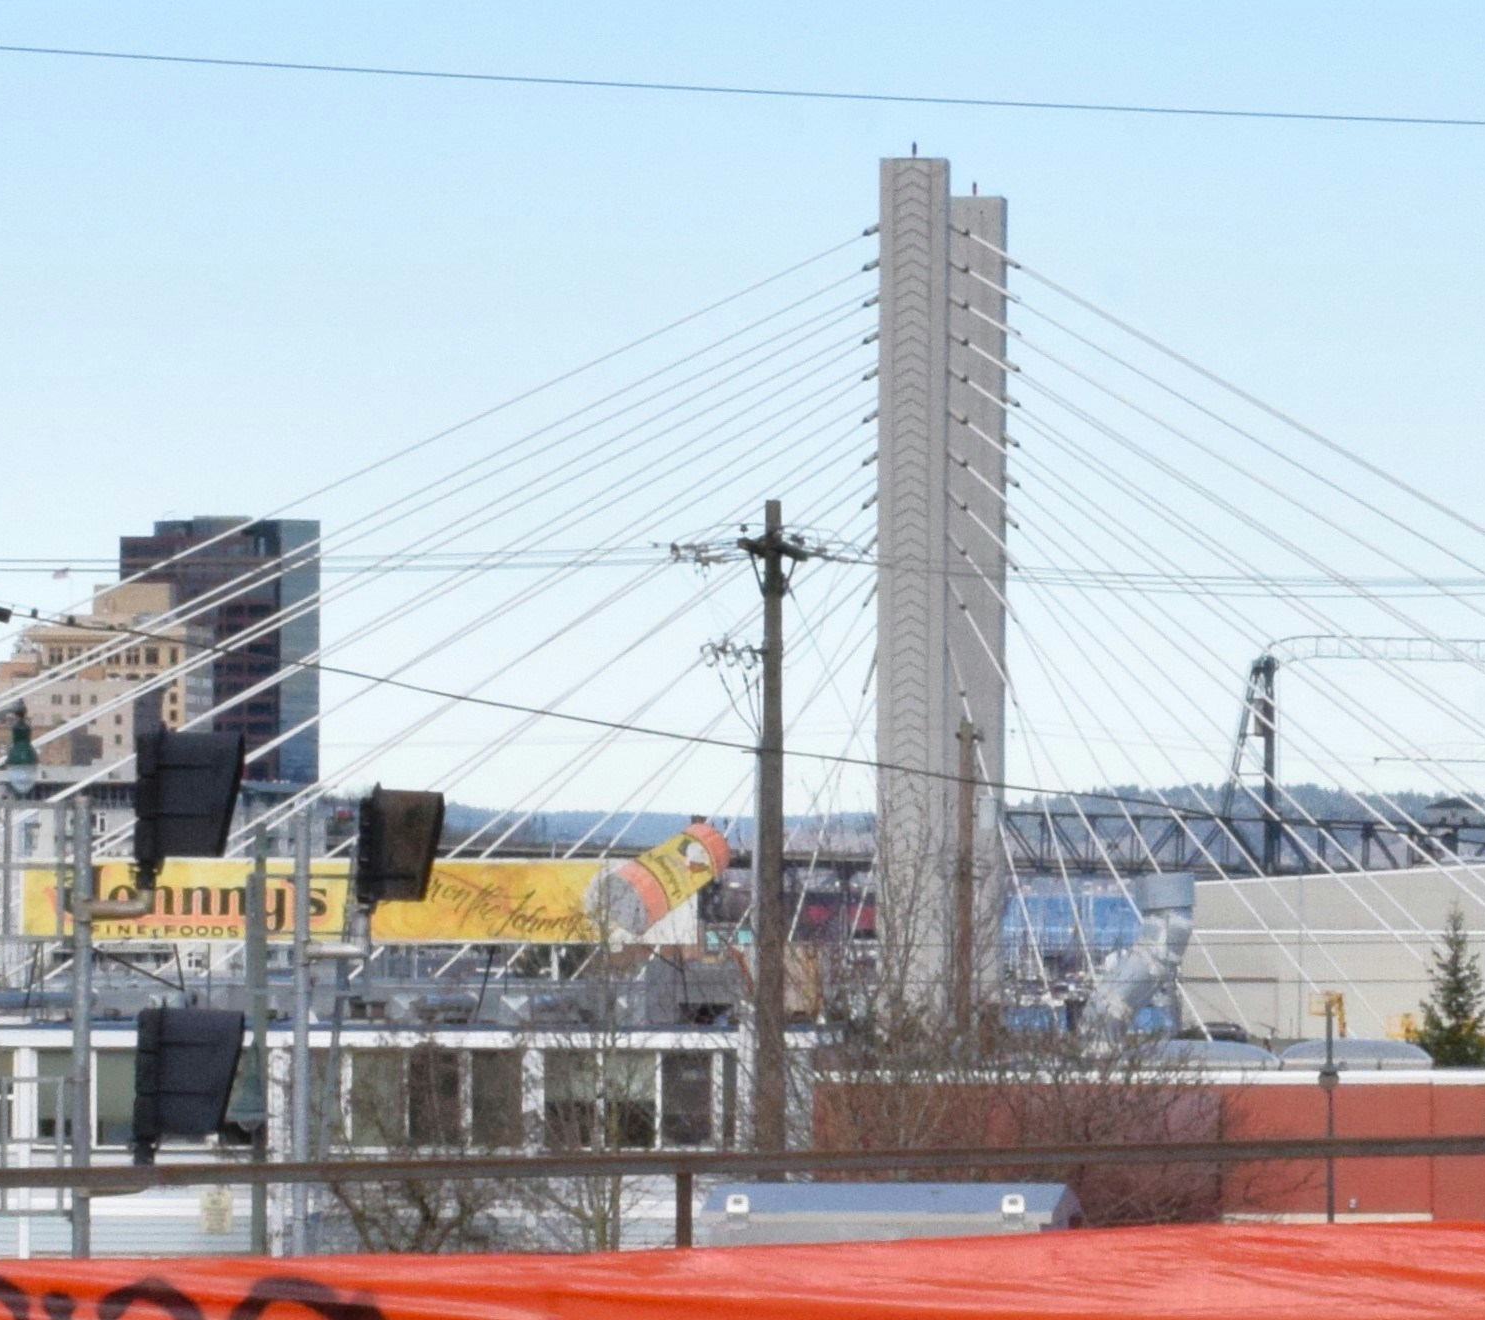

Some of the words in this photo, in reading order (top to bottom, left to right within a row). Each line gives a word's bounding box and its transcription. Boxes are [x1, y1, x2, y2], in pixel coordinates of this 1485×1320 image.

[60, 864, 329, 932] Jonnys
[90, 924, 147, 937] FINE
[164, 924, 240, 938] FOODS
